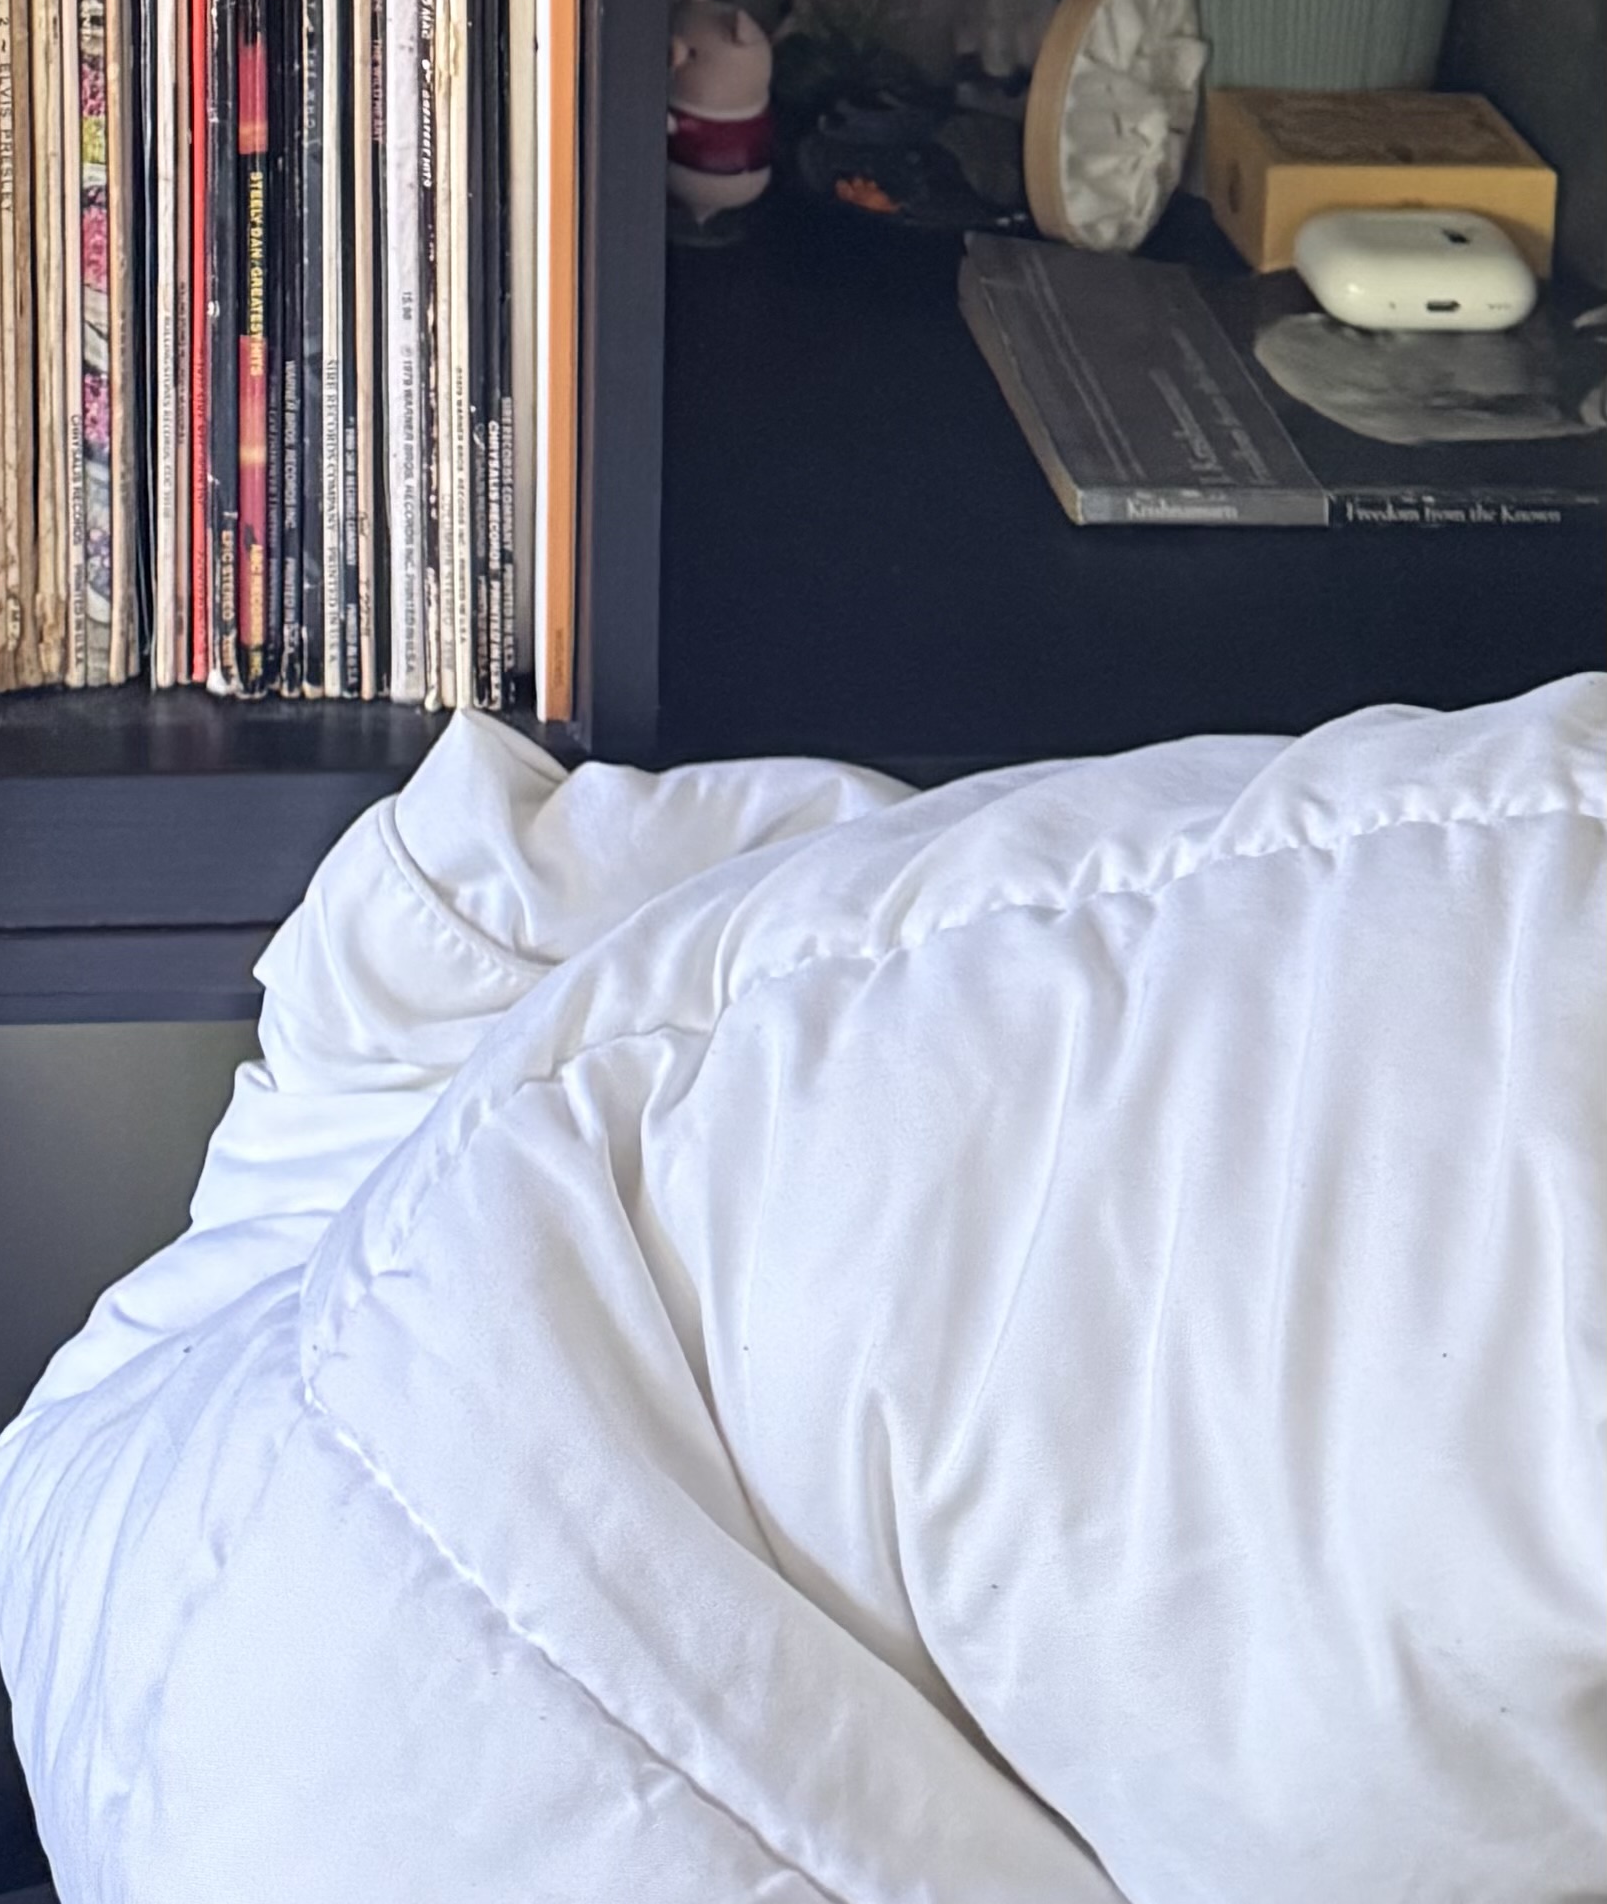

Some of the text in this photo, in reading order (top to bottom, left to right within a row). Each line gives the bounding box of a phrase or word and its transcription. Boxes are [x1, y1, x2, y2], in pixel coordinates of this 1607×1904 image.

[0, 129, 12, 213] PRESLEY
[251, 172, 262, 224] STEELY
[251, 228, 262, 260] DAN
[251, 342, 262, 375] HITS
